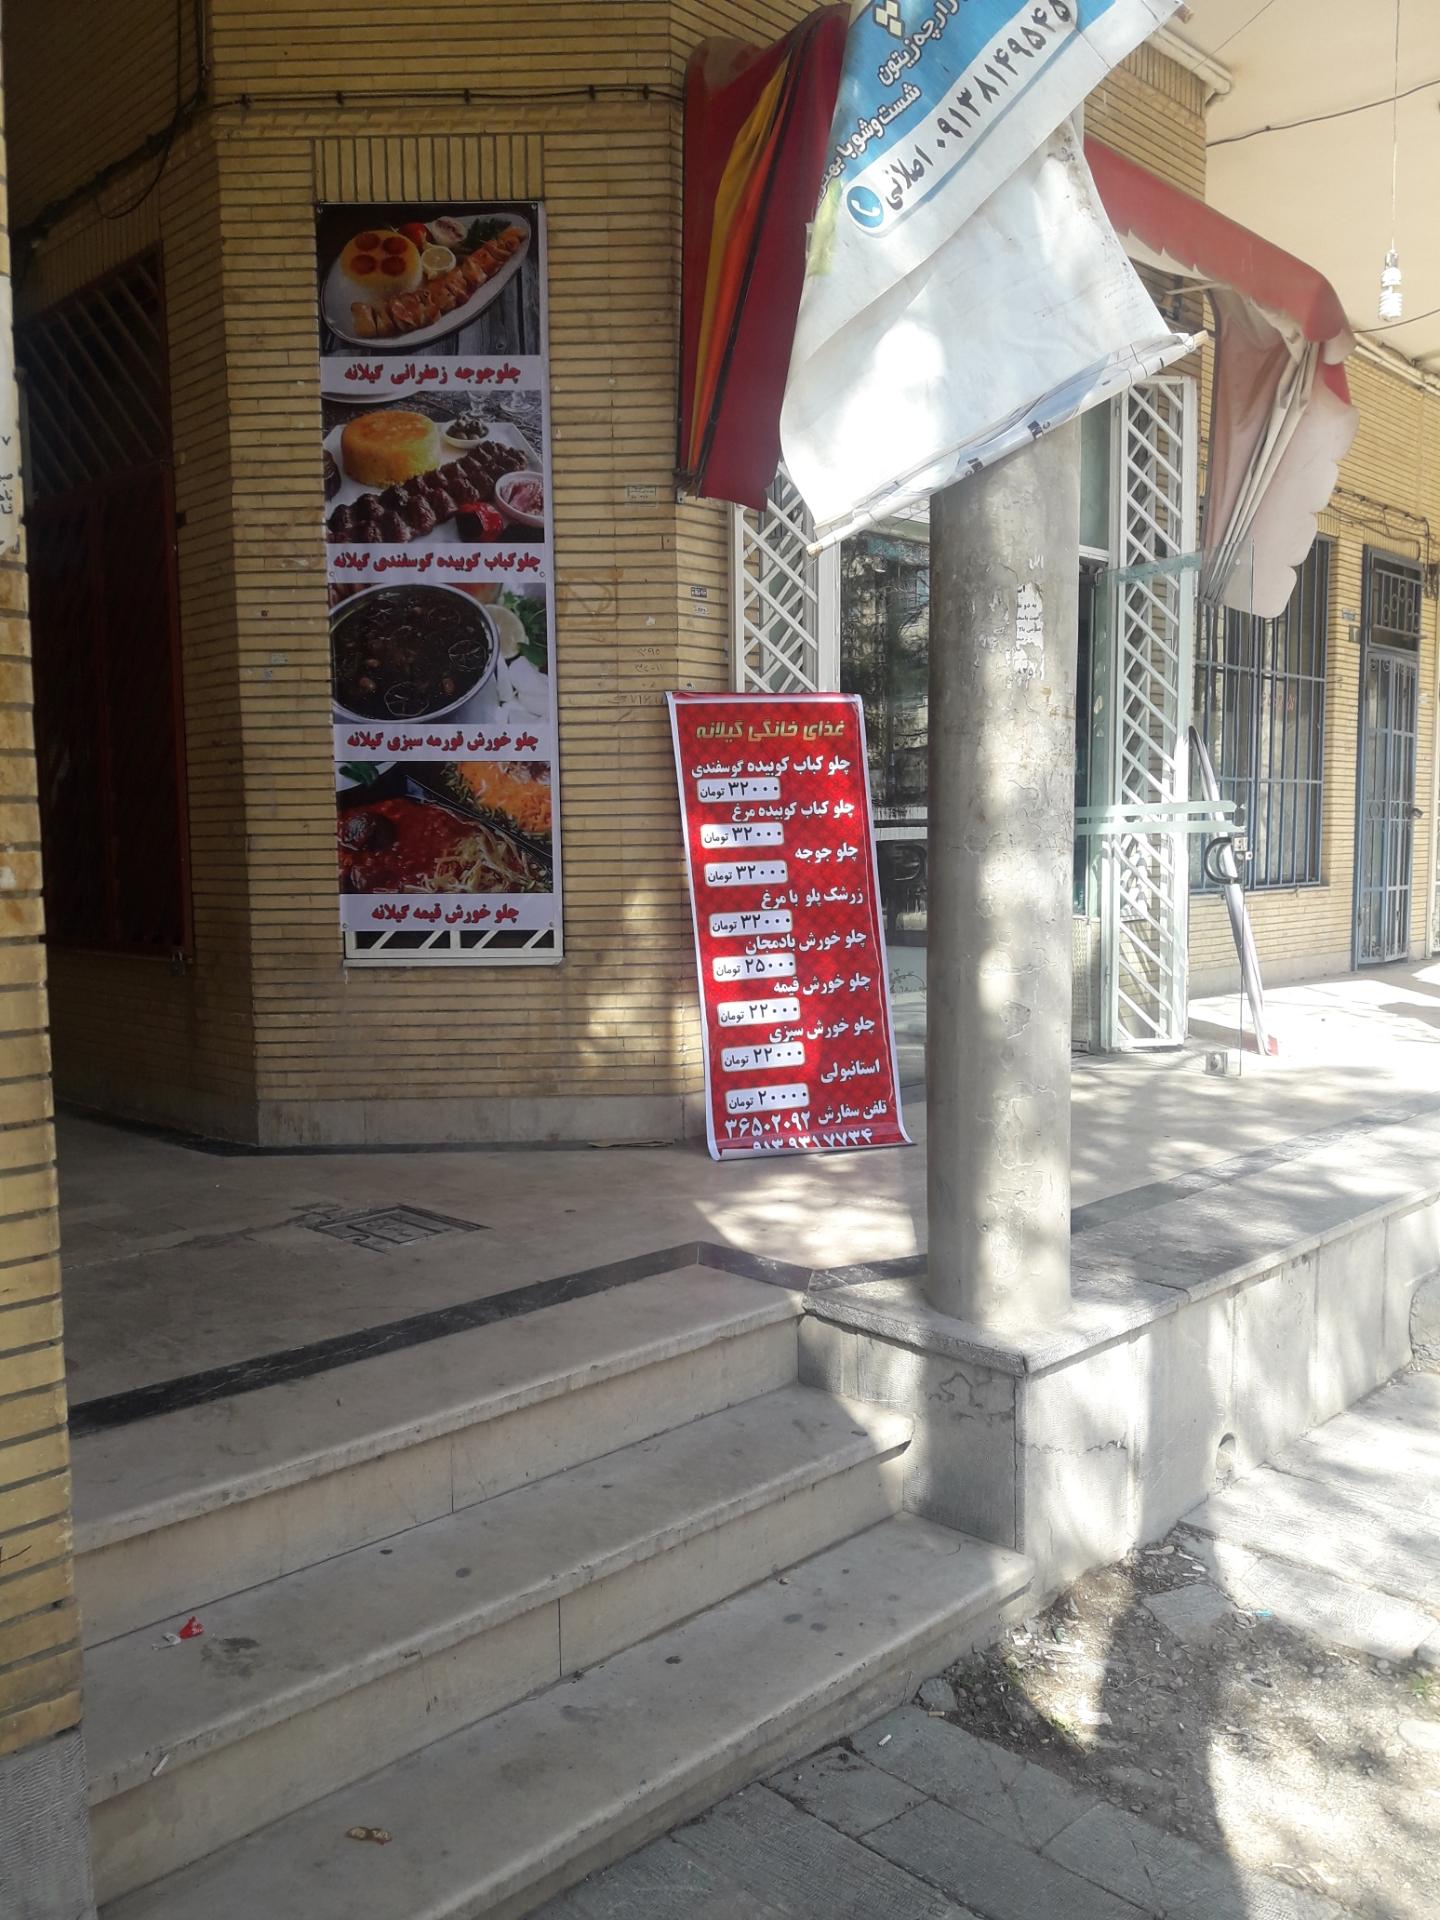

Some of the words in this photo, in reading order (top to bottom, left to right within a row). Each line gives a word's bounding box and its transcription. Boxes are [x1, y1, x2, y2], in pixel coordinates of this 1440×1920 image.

[885, 143, 935, 212] اصلانی
[344, 362, 384, 384] گیلانه
[390, 363, 448, 385] زعفرانی
[333, 551, 370, 572] گیلانه
[373, 552, 434, 573] گوسفندی
[437, 552, 481, 573] کوبیده
[696, 720, 744, 743] گیلانه
[747, 721, 798, 742] خانگی
[803, 720, 846, 741] غذای
[347, 731, 384, 751] گیلانه
[386, 732, 423, 752] سبزی
[426, 731, 464, 752] قورمه
[467, 732, 512, 752] خورش
[514, 732, 539, 752] چلو
[691, 759, 744, 778] گوسفندی
[747, 756, 790, 777] کوبیده
[793, 755, 824, 775] کباب
[828, 755, 851, 776] چلو
[700, 787, 725, 799] تومان
[728, 781, 779, 797] ۳۲۰۰۰
[732, 803, 755, 822] مرغ
[758, 802, 797, 820] کوبیده
[800, 800, 829, 819] کباب
[833, 799, 855, 819] چلو
[704, 832, 728, 844] تومان
[732, 827, 782, 842] ۳۲۰۰۰
[795, 846, 832, 864] جوجه
[836, 842, 859, 862] چلو
[708, 870, 732, 883] تومان
[736, 865, 785, 880] ۳۲۰۰۰
[761, 889, 787, 910] مرغ
[788, 889, 799, 905] با
[805, 888, 821, 907] پلو
[824, 886, 864, 905] زرشک
[371, 904, 410, 923] گیلانه
[413, 903, 442, 923] قیمه
[444, 904, 492, 925] خورش
[494, 904, 520, 924] چلو
[740, 914, 790, 929] ۳۲۰۰۰
[712, 920, 737, 932] تومان
[745, 933, 796, 955] بادمجان
[799, 930, 841, 952] خورش
[844, 929, 867, 949] چلو
[716, 964, 741, 977] تومان
[745, 959, 794, 973] ۲۵۰۰۰
[773, 975, 799, 996] قیمه
[802, 974, 844, 996] خورش
[849, 972, 871, 991] چلو
[720, 1011, 745, 1024] تومان
[748, 1003, 798, 1019] ۲۲۰۰۰
[769, 1024, 804, 1043] سبزی
[806, 1018, 849, 1039] خورش
[853, 1016, 875, 1036] چلو
[724, 1055, 749, 1067] تومان
[753, 1048, 803, 1063] ۲۲۰۰۰
[820, 1058, 880, 1083] استانبولی
[728, 1098, 754, 1110] تومان
[758, 1090, 807, 1106] ۲۰۰۰۰
[817, 1103, 860, 1125] سفارش
[862, 1099, 887, 1120] تلفن
